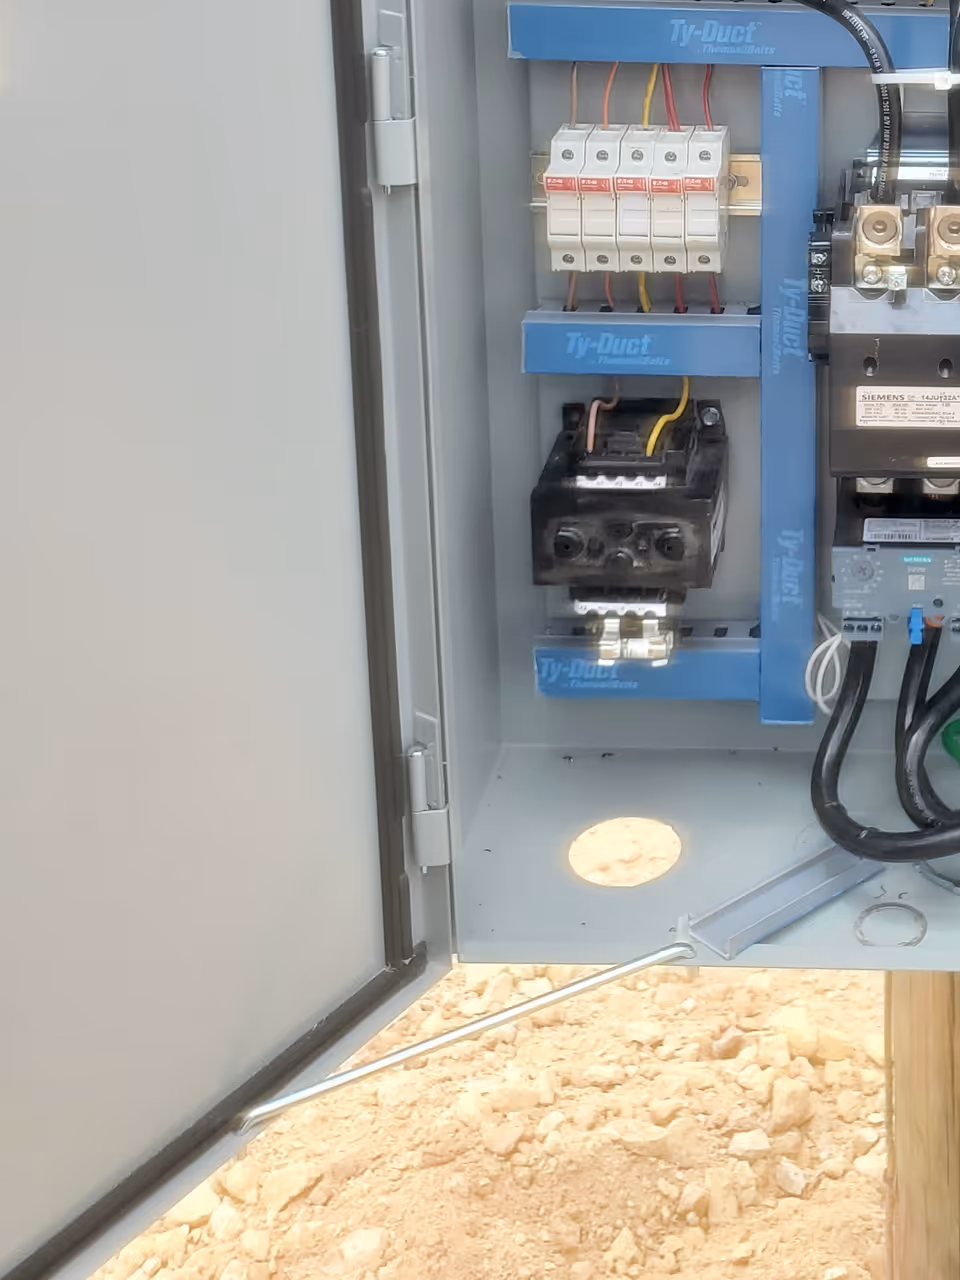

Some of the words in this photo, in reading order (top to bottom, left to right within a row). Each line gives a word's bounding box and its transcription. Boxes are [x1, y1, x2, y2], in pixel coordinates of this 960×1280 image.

[670, 19, 757, 48] Ty-Duct
[779, 279, 807, 357] Ty-Duct
[566, 332, 653, 358] Ty-Duct
